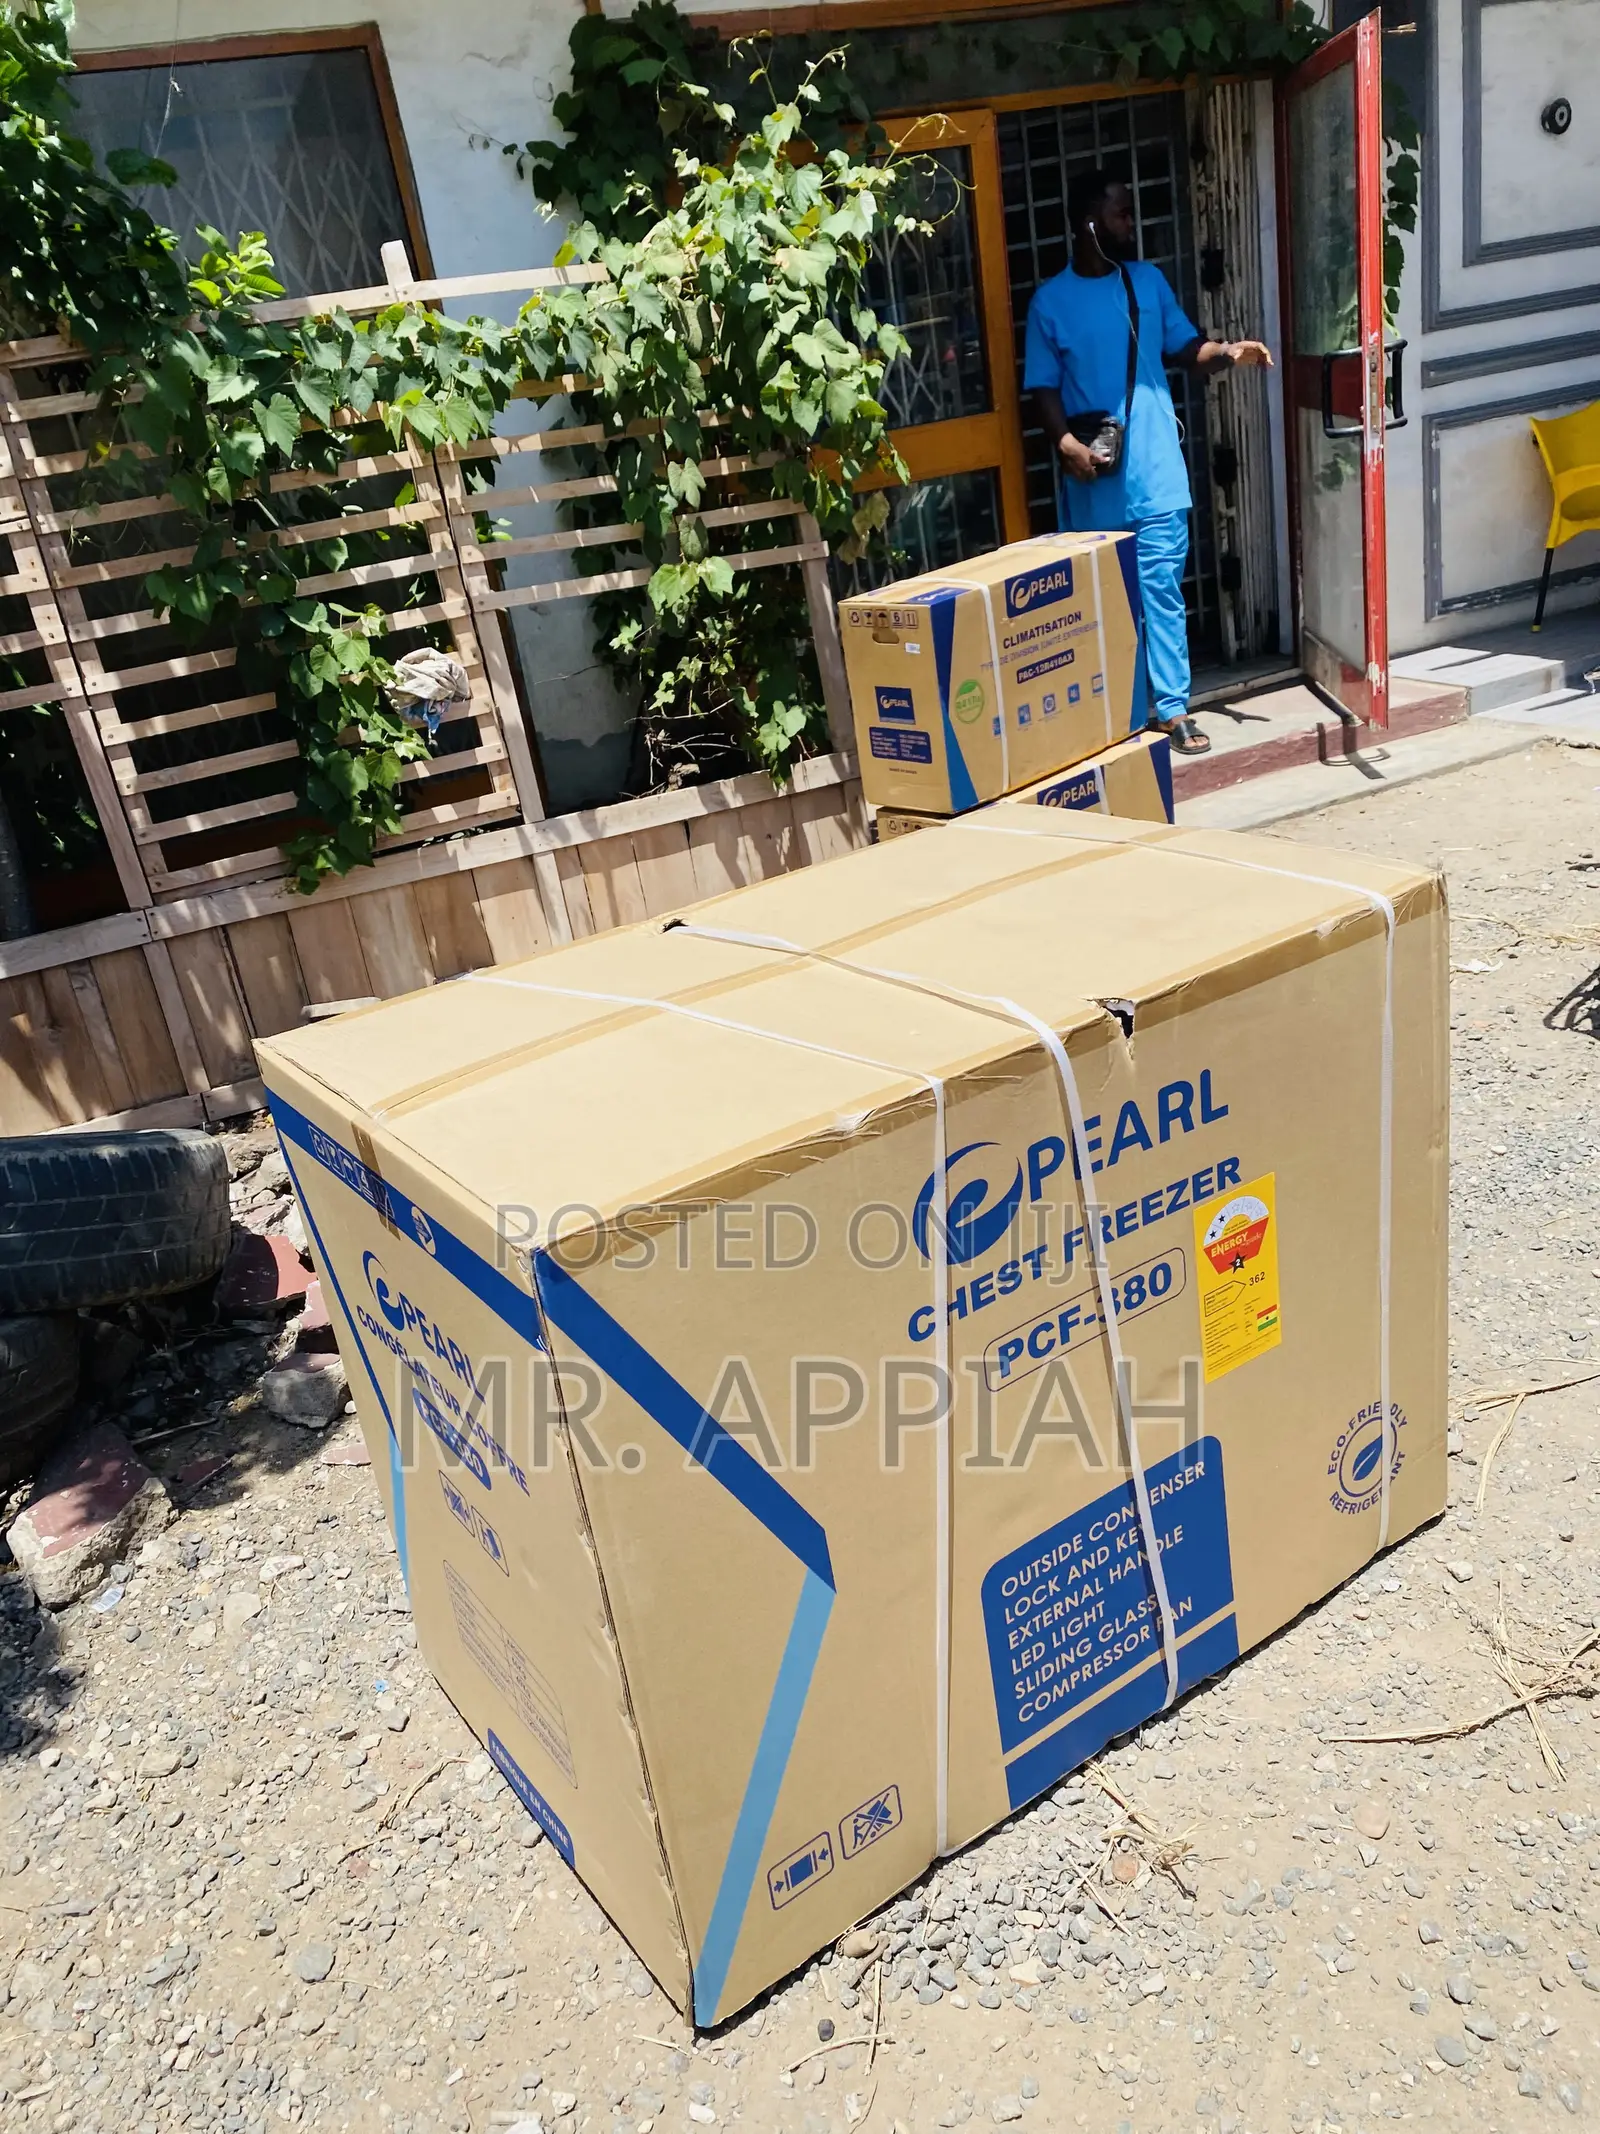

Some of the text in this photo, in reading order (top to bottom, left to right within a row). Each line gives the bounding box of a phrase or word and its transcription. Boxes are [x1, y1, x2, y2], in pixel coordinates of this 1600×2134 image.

[1031, 570, 1069, 597] PEARL
[1003, 611, 1082, 649] CLIMATISATION
[1063, 779, 1098, 805] PEAR
[1027, 1068, 1229, 1202] PEARL
[908, 1156, 1242, 1342] CHEST FREEZER
[1211, 1232, 1248, 1258] ENERGY
[1249, 1272, 1265, 1286] 362
[398, 1291, 486, 1405] PEARL
[1327, 1400, 1407, 1475] ECO-FRIEDLY
[1002, 1461, 1206, 1598] OUTSIDE CONENSER
[1004, 1576, 1061, 1625] LOCK
[1067, 1546, 1110, 1586] AND
[1007, 1576, 1104, 1651] EXTERNAL
[1011, 1600, 1105, 1676] LED LIGHT
[1014, 1594, 1158, 1700] SLIDING GLASS
[1018, 1627, 1151, 1724] COMPRESSOR
[542, 1808, 570, 1848] CHINE
